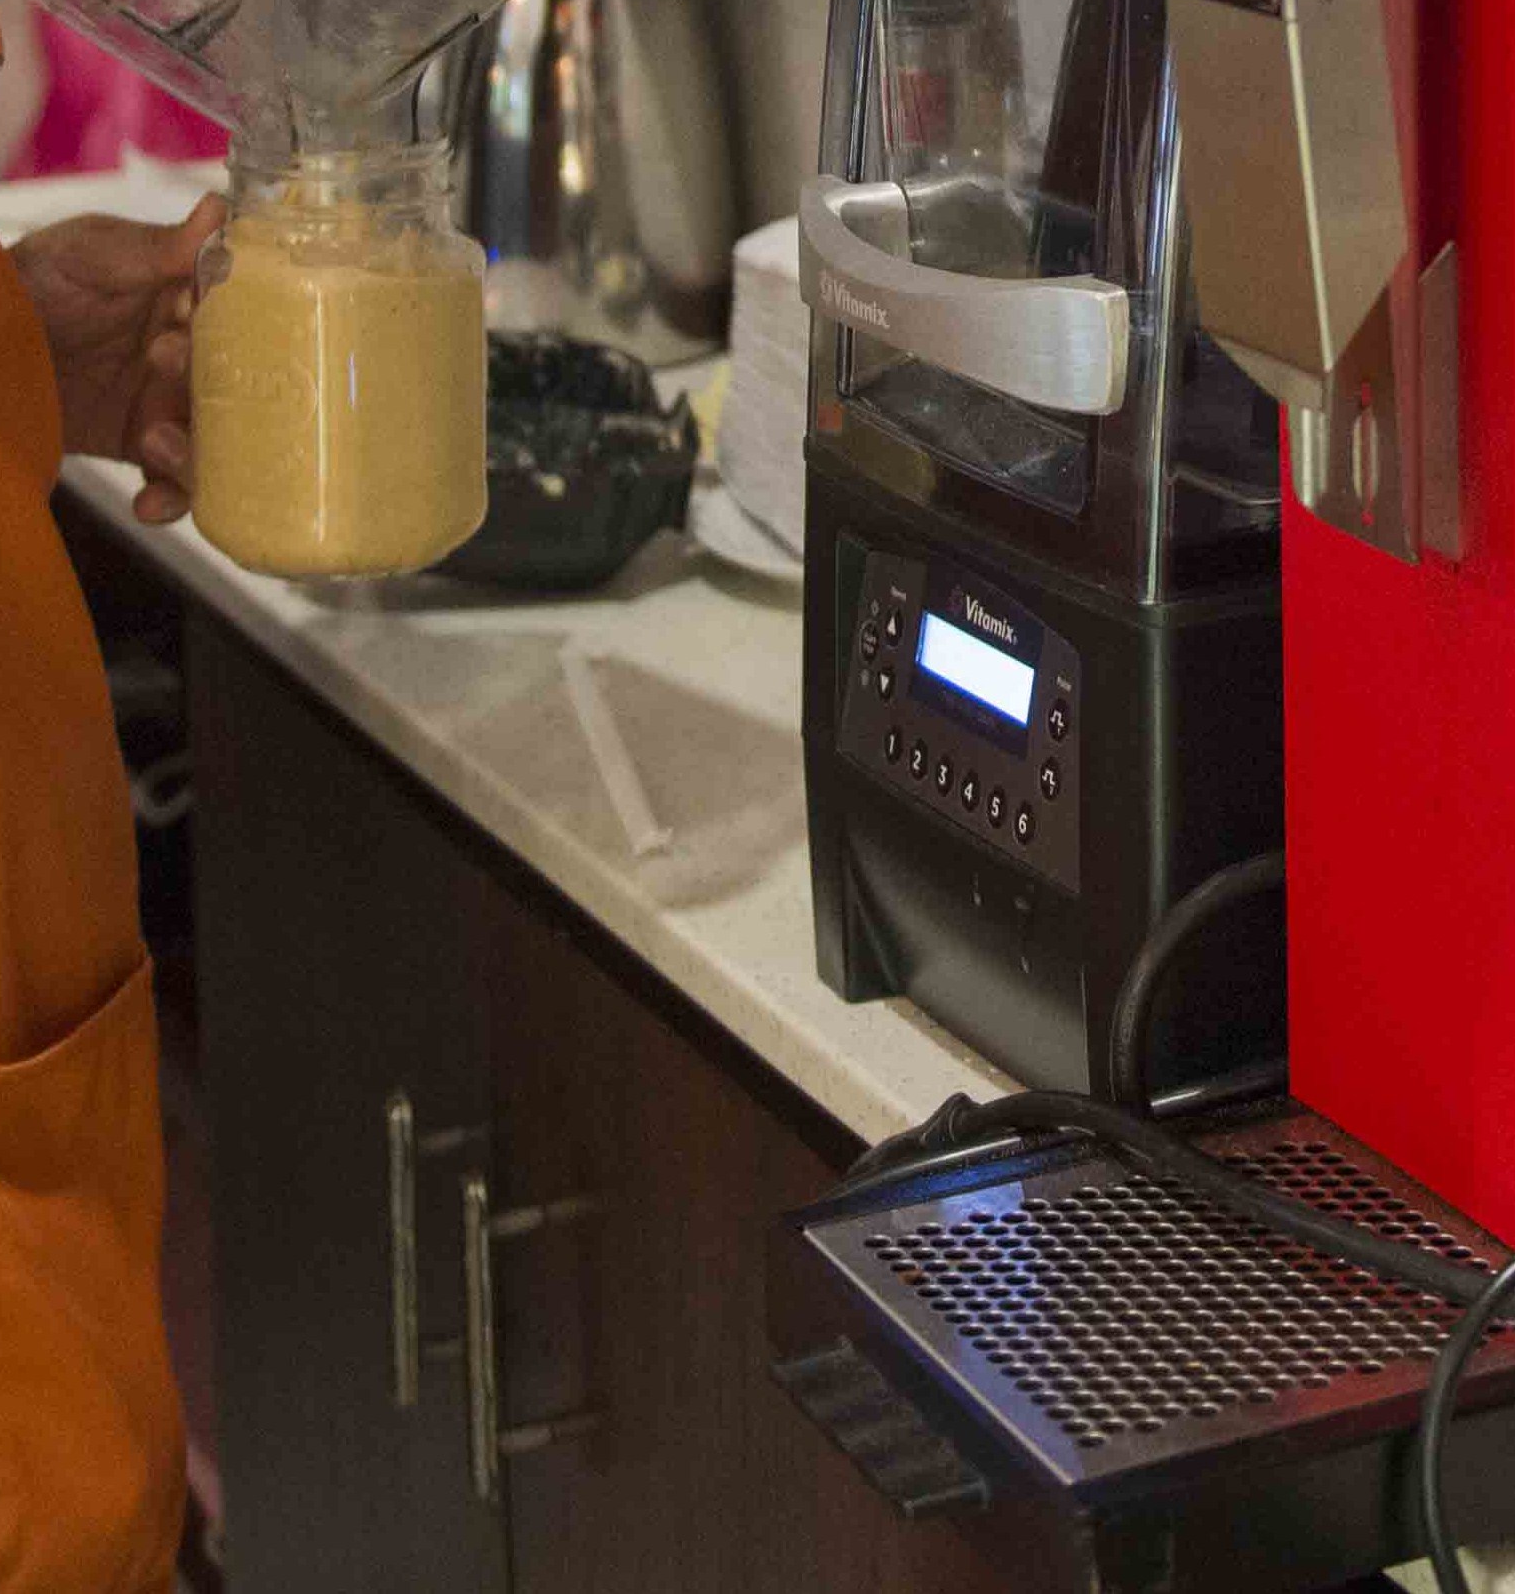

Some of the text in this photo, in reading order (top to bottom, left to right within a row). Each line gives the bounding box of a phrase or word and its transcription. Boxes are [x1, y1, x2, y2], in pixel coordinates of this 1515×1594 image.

[833, 278, 887, 326] Vitamix
[965, 594, 1015, 644] Vitamix
[887, 734, 1028, 834] 1 2 3 4 5 6
